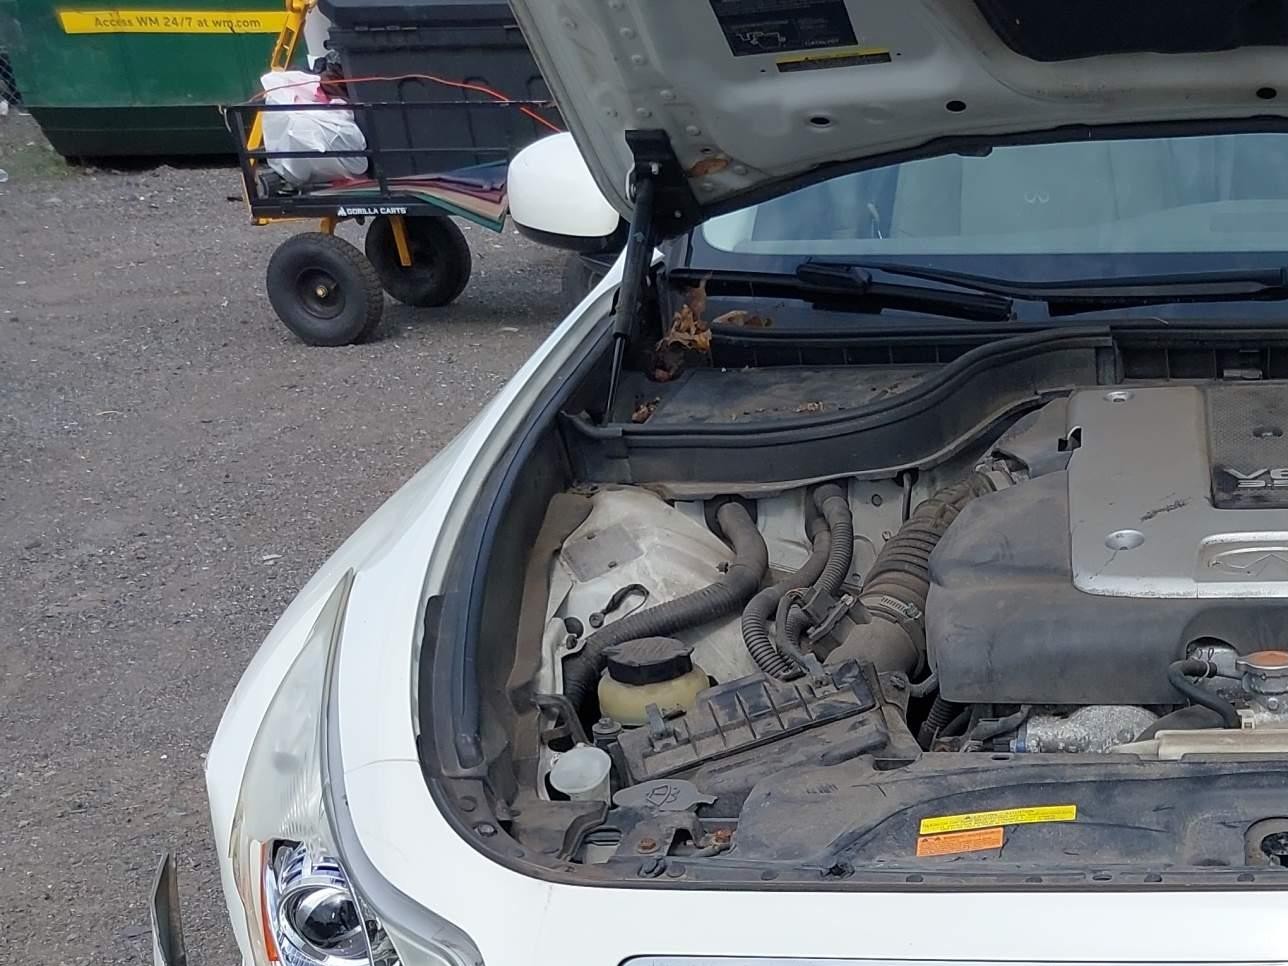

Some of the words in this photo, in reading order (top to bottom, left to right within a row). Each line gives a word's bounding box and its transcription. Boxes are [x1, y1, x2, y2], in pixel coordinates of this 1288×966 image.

[94, 16, 133, 28] Access
[136, 16, 160, 28] WM
[163, 16, 193, 28] 24/7
[197, 17, 209, 28] at
[212, 18, 261, 29] wm.com
[346, 207, 379, 215] GORILLA
[380, 207, 407, 215] CARTS
